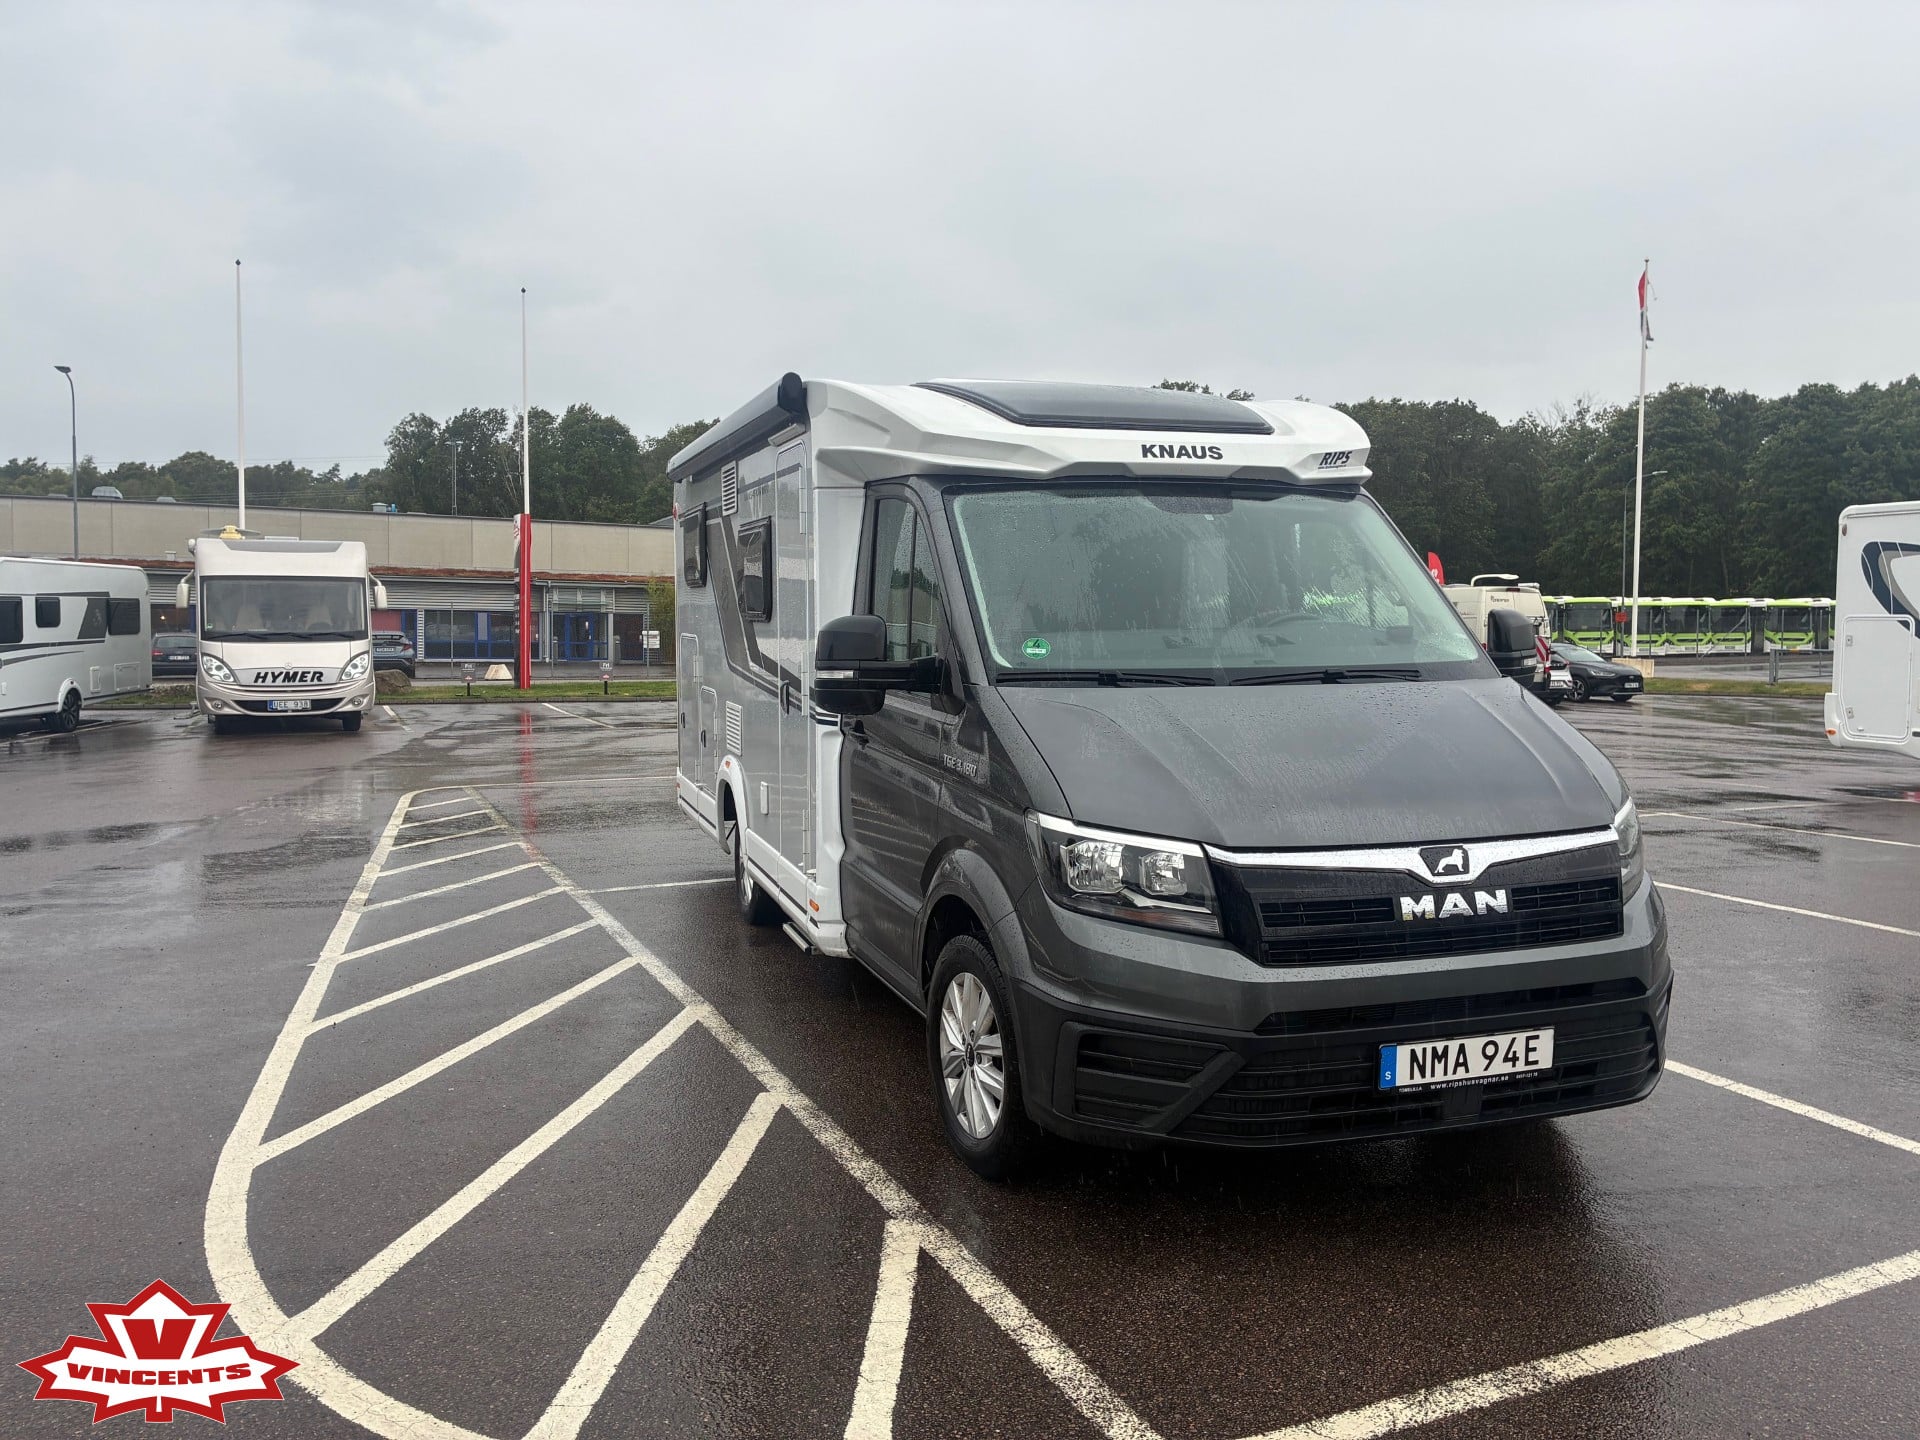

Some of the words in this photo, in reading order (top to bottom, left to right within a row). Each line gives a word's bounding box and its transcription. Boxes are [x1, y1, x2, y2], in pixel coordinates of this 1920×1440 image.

[1141, 444, 1224, 460] KNAUS
[1319, 450, 1353, 466] RIPS
[254, 671, 324, 684] HYMER
[1400, 889, 1509, 921] MAN
[1409, 1043, 1470, 1081] NMA
[1481, 1034, 1541, 1072] 94E
[1384, 1071, 1392, 1080] S
